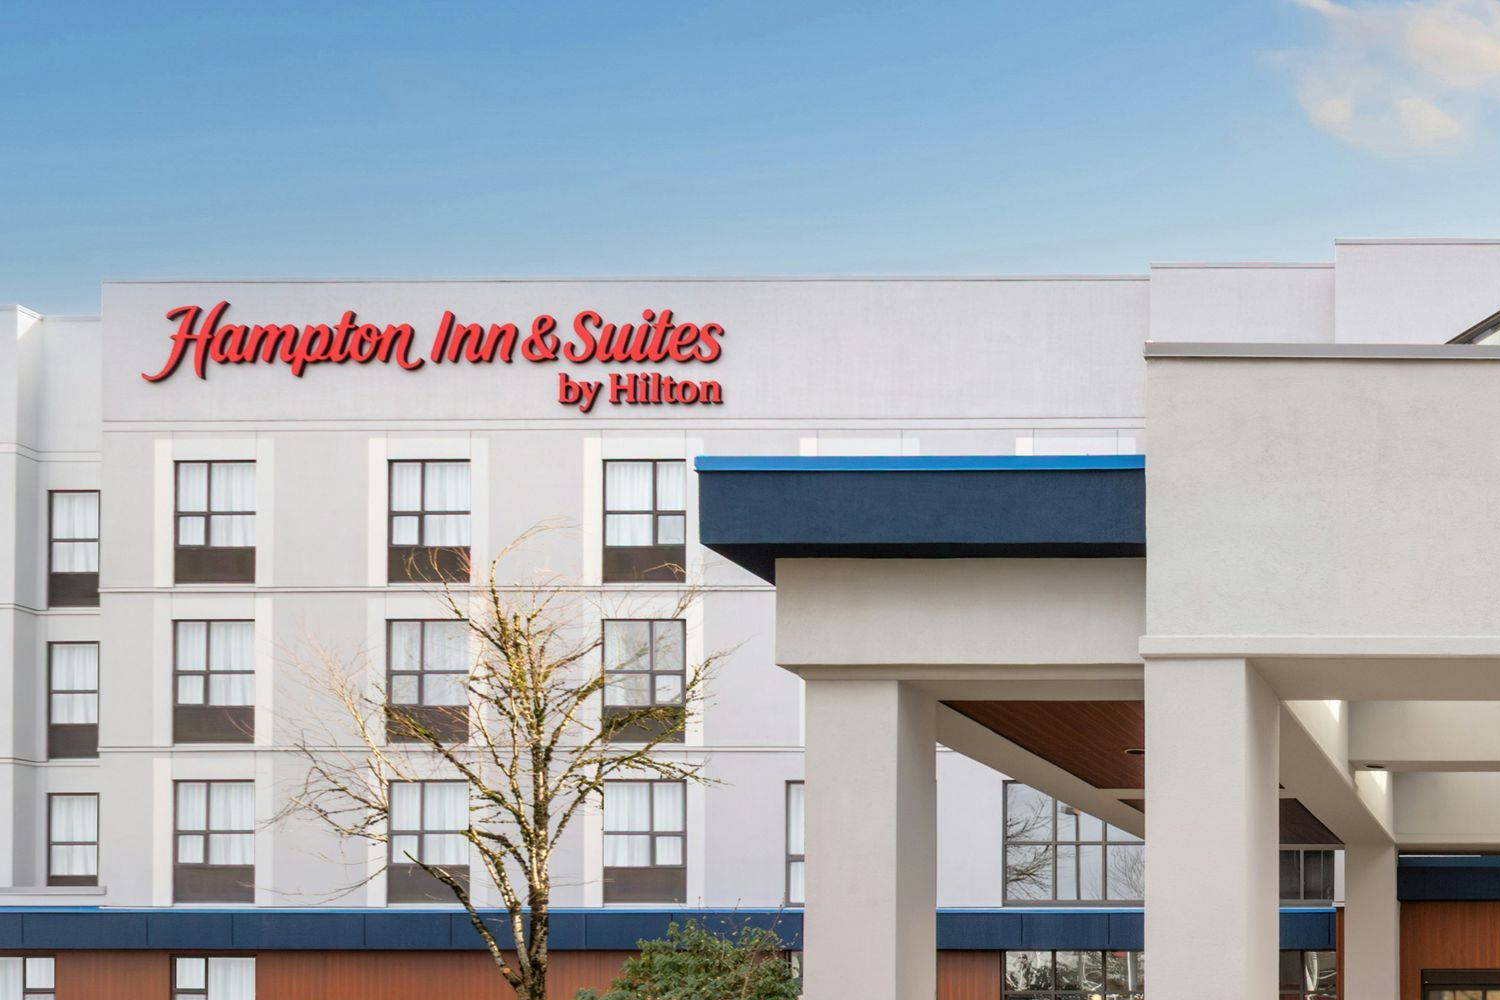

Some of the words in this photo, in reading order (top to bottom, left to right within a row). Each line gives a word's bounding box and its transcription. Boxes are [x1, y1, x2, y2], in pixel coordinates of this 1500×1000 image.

[142, 301, 425, 384] Hampton
[430, 310, 519, 365] Inn
[562, 309, 725, 365] Suites
[559, 372, 603, 414] by
[609, 372, 724, 405] Hilton
